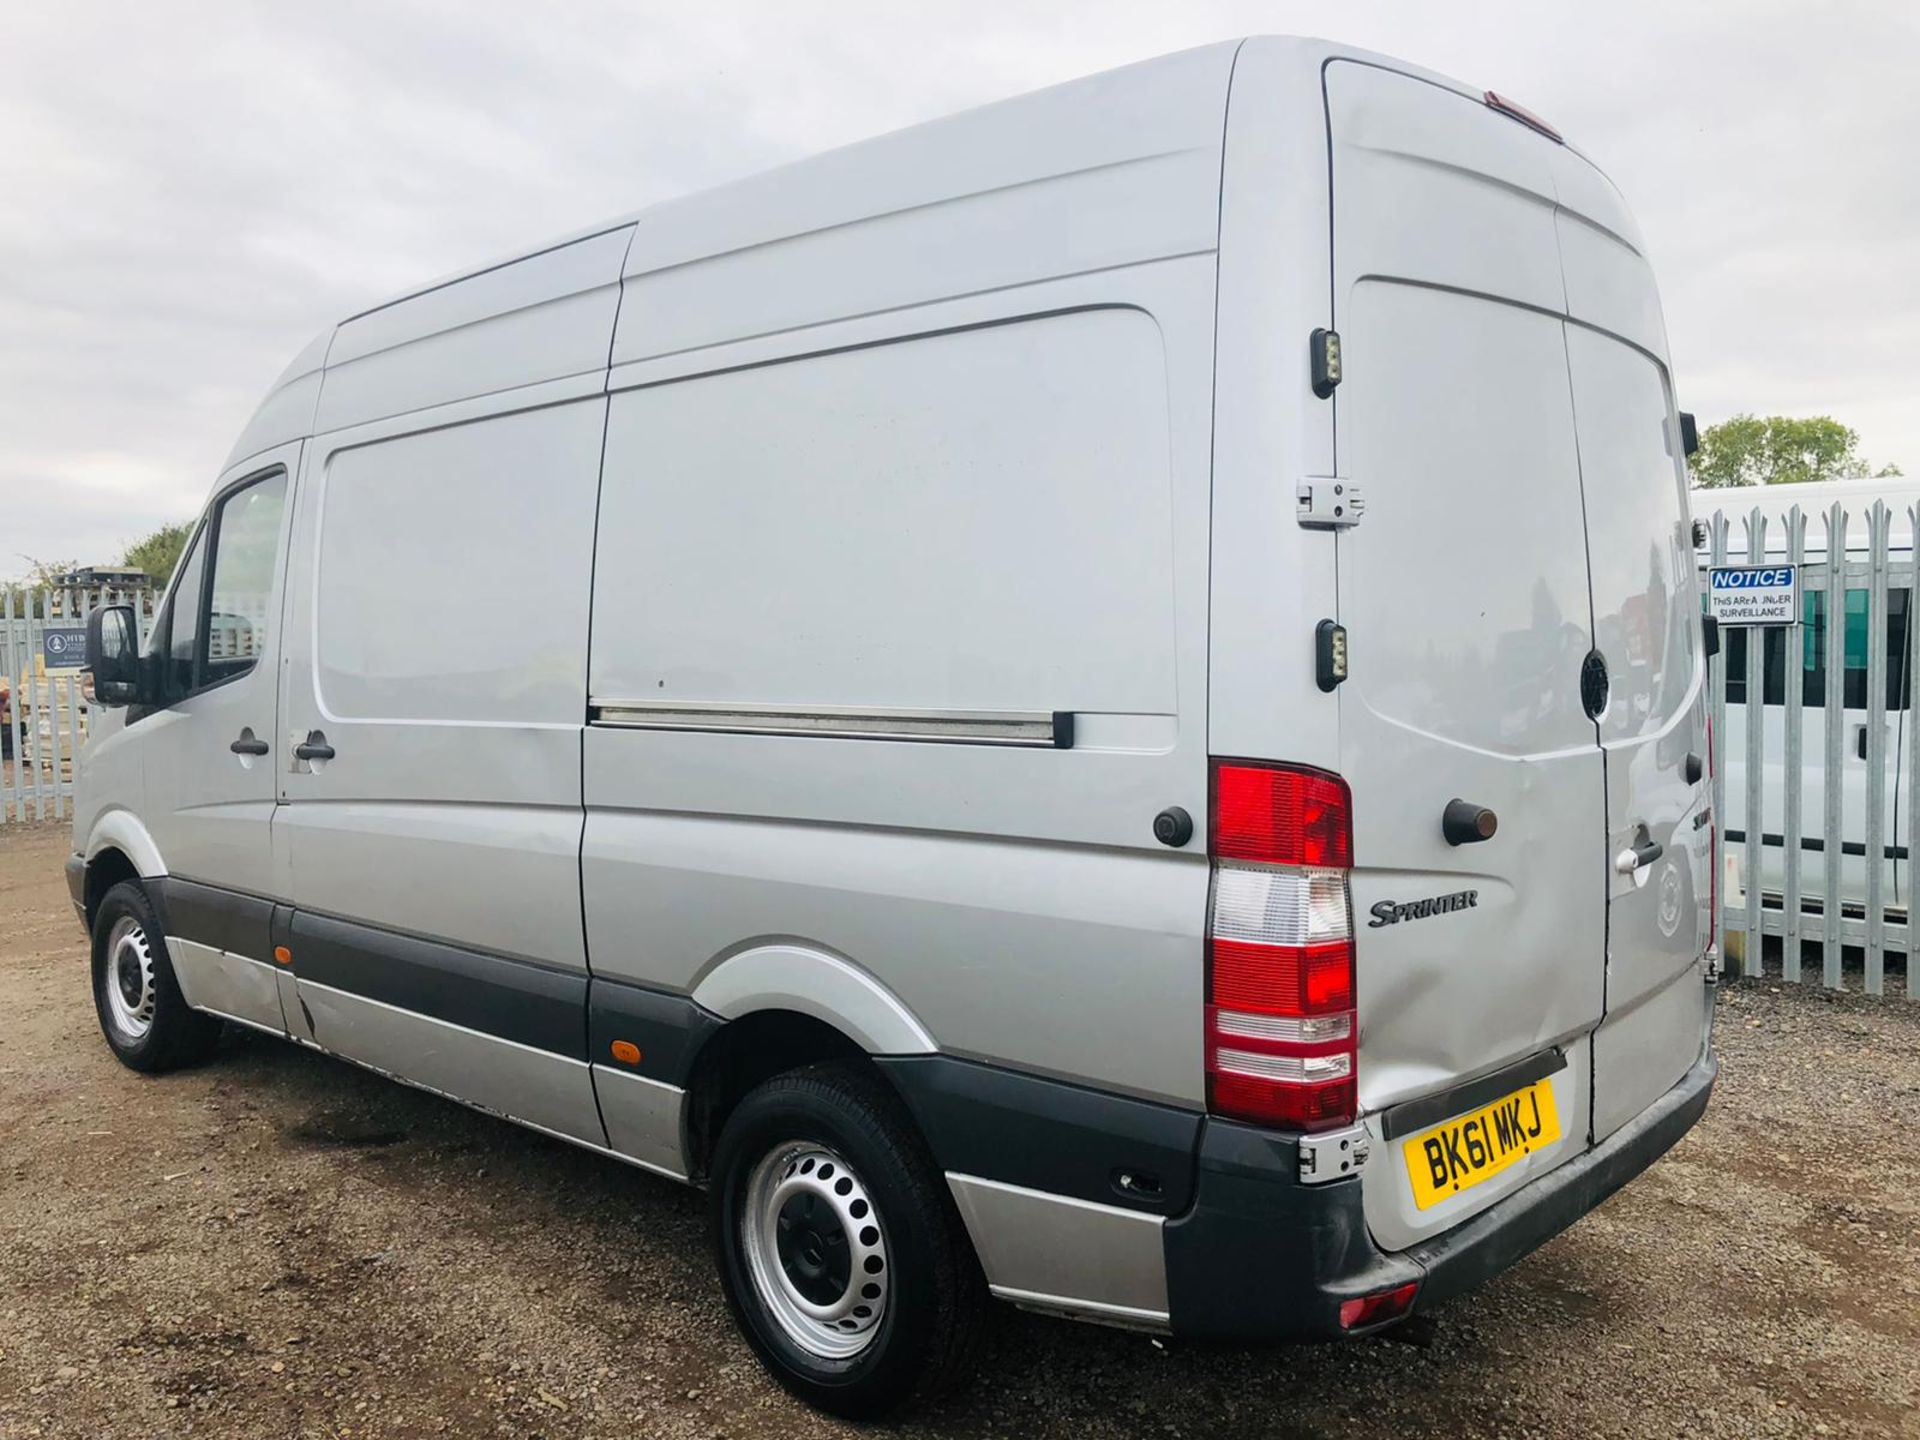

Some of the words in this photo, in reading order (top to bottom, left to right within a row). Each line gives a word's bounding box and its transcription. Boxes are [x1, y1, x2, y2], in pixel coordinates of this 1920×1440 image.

[1714, 569, 1788, 587] NOTICE
[1719, 606, 1786, 618] SURVEILLANCE
[1368, 889, 1478, 928] SPRINTER
[1423, 1115, 1494, 1189] BK61
[1493, 1091, 1541, 1156] MKJ
